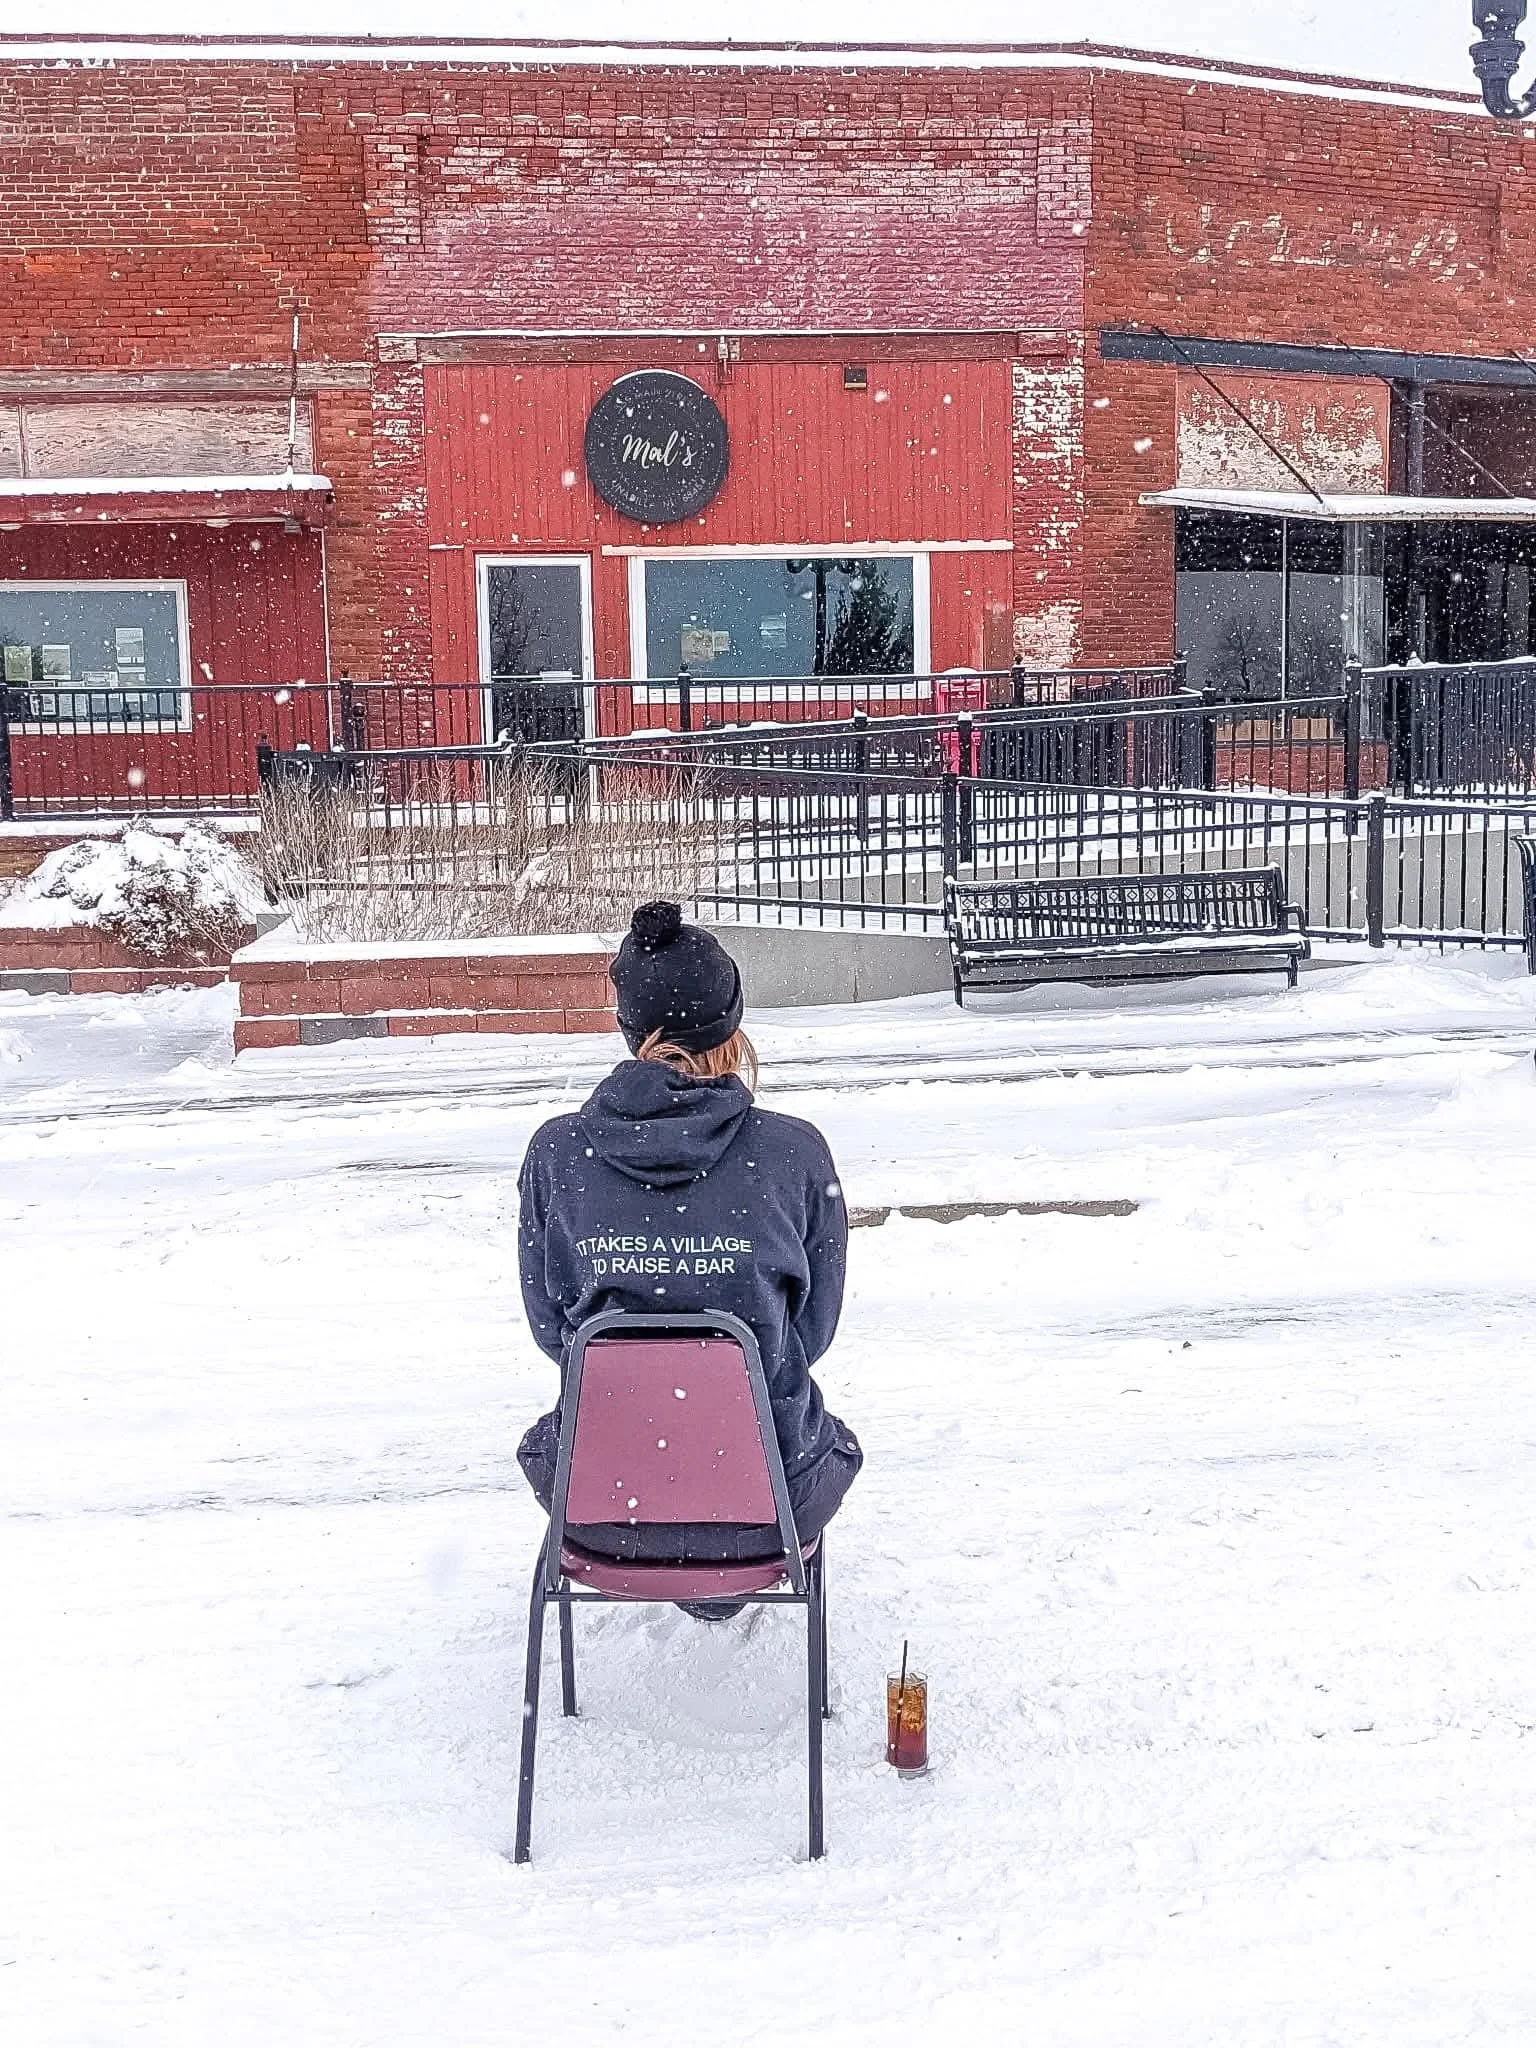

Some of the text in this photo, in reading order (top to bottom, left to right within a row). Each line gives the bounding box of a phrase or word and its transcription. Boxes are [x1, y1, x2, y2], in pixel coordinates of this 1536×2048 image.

[622, 430, 698, 469] Mal's
[576, 1235, 753, 1257] IT TAKES A VILLAGE
[592, 1257, 735, 1276] TO RAISE A BAR
